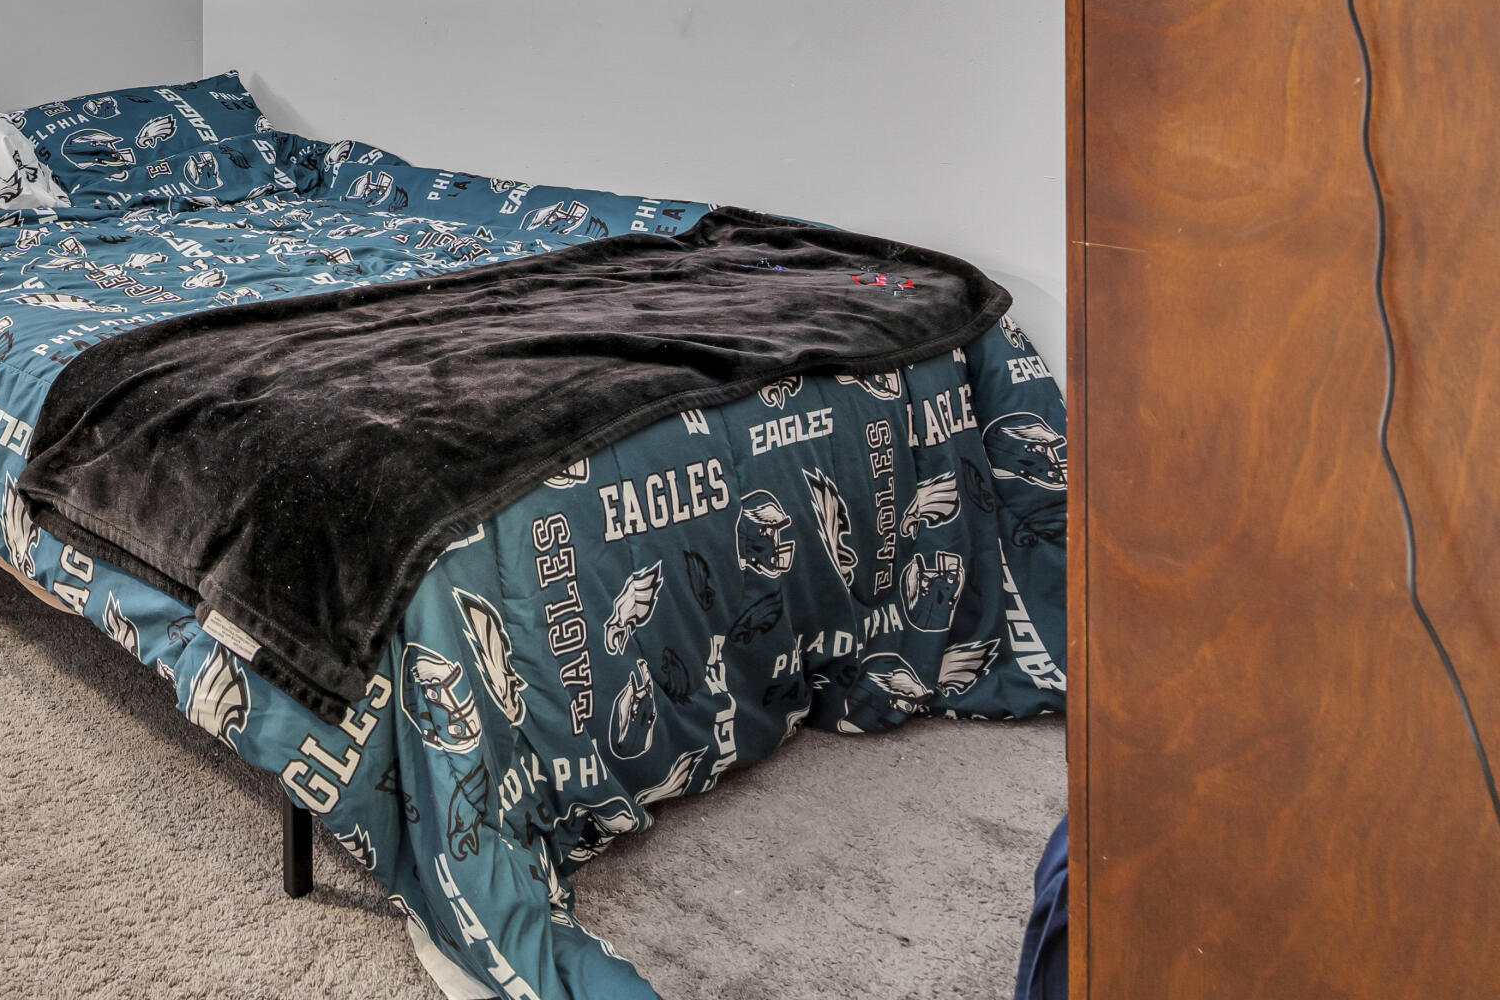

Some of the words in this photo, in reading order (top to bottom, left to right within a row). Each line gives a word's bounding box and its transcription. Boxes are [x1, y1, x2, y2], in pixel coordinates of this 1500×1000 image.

[748, 406, 835, 457] EAGLES
[600, 456, 732, 543] EAGLES
[530, 511, 596, 737] EAGLES
